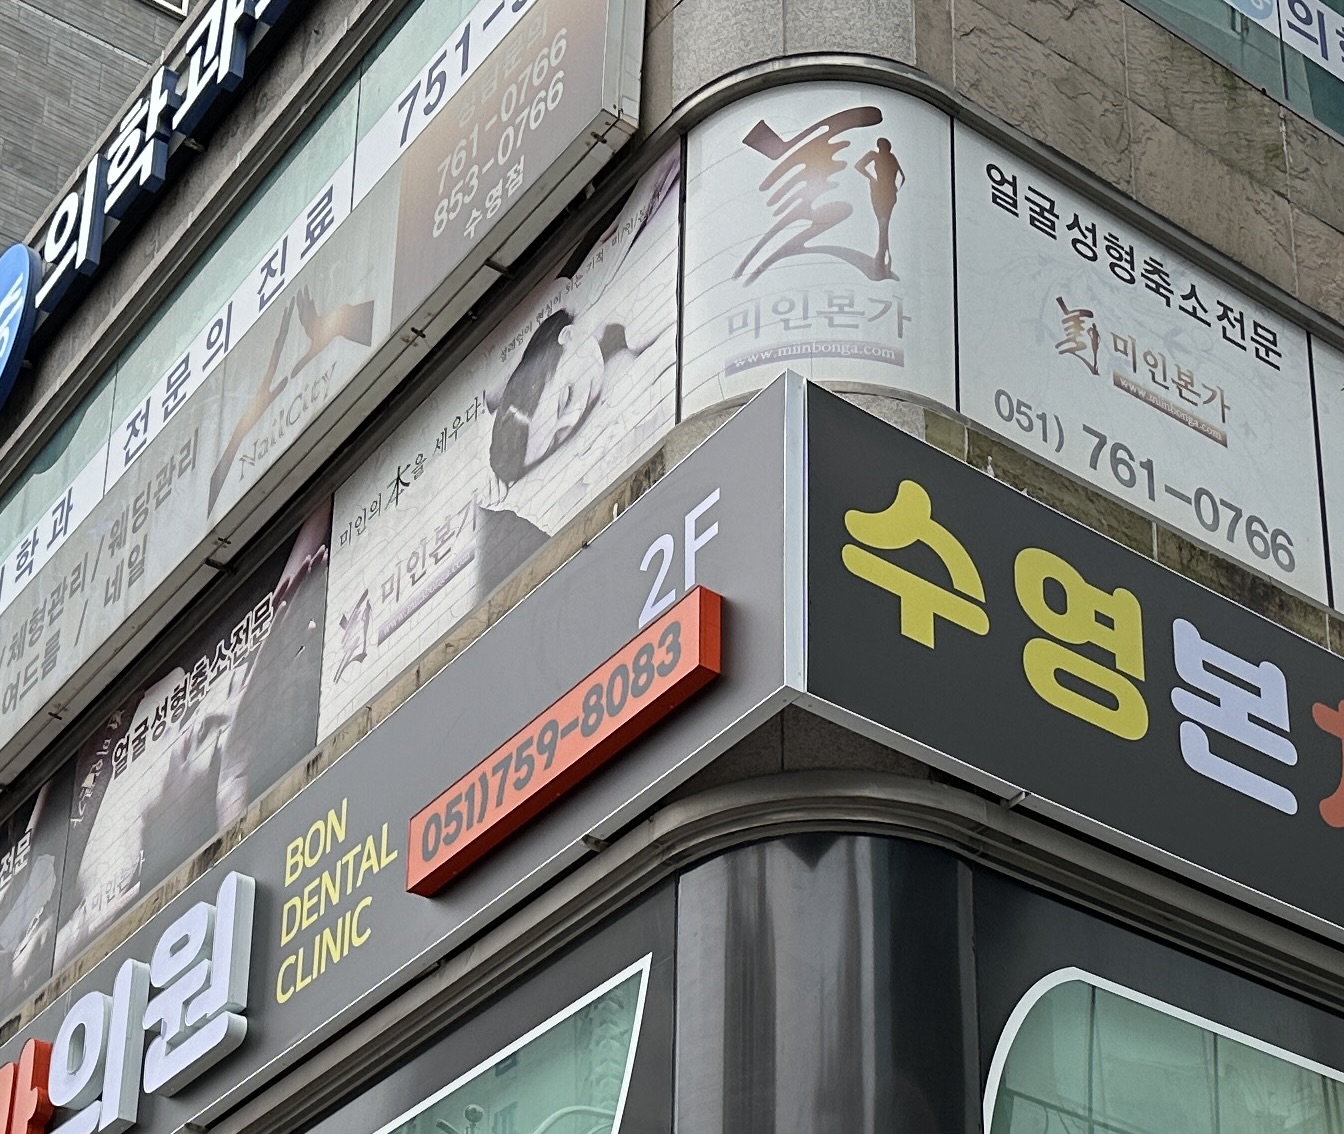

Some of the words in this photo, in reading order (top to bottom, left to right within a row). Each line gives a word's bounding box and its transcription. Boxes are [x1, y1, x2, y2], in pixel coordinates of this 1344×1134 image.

[397, 0, 529, 148] 751-
[437, 27, 567, 195] 761-0766
[36, 0, 270, 310] 의학과
[432, 70, 565, 238] 853-0766
[464, 154, 525, 240] 수영점
[727, 289, 912, 339] 미인본가
[985, 162, 1283, 371] 얼굴성형축소전문
[1110, 332, 1230, 424] 미인본가
[339, 493, 382, 547] 미인의
[637, 487, 722, 629] 2F
[280, 821, 398, 948] DENTAL
[285, 797, 349, 888] BON
[275, 895, 373, 1005] CLINIC
